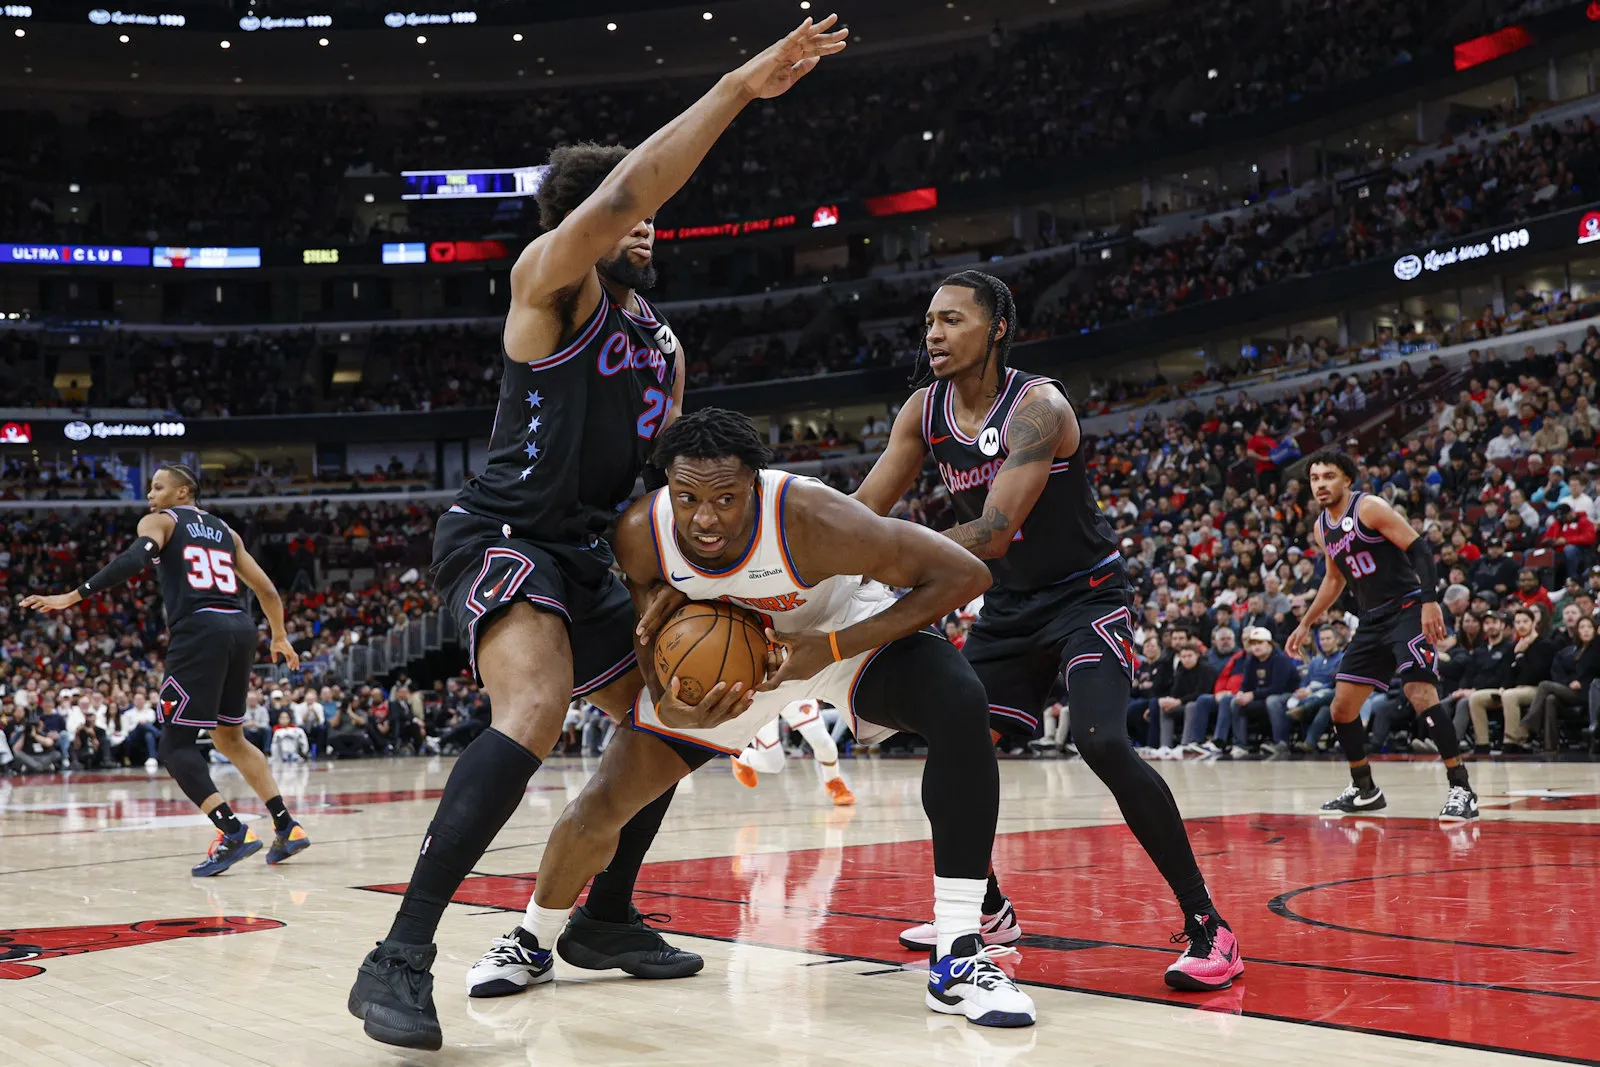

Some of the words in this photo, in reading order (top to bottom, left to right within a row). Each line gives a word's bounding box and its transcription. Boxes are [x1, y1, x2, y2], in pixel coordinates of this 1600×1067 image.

[12, 247, 60, 261] ULTRA
[73, 248, 123, 262] CLUB
[1491, 228, 1530, 254] 1899
[597, 331, 667, 384] Chicag
[183, 544, 239, 595] 35
[1345, 550, 1377, 579] 30
